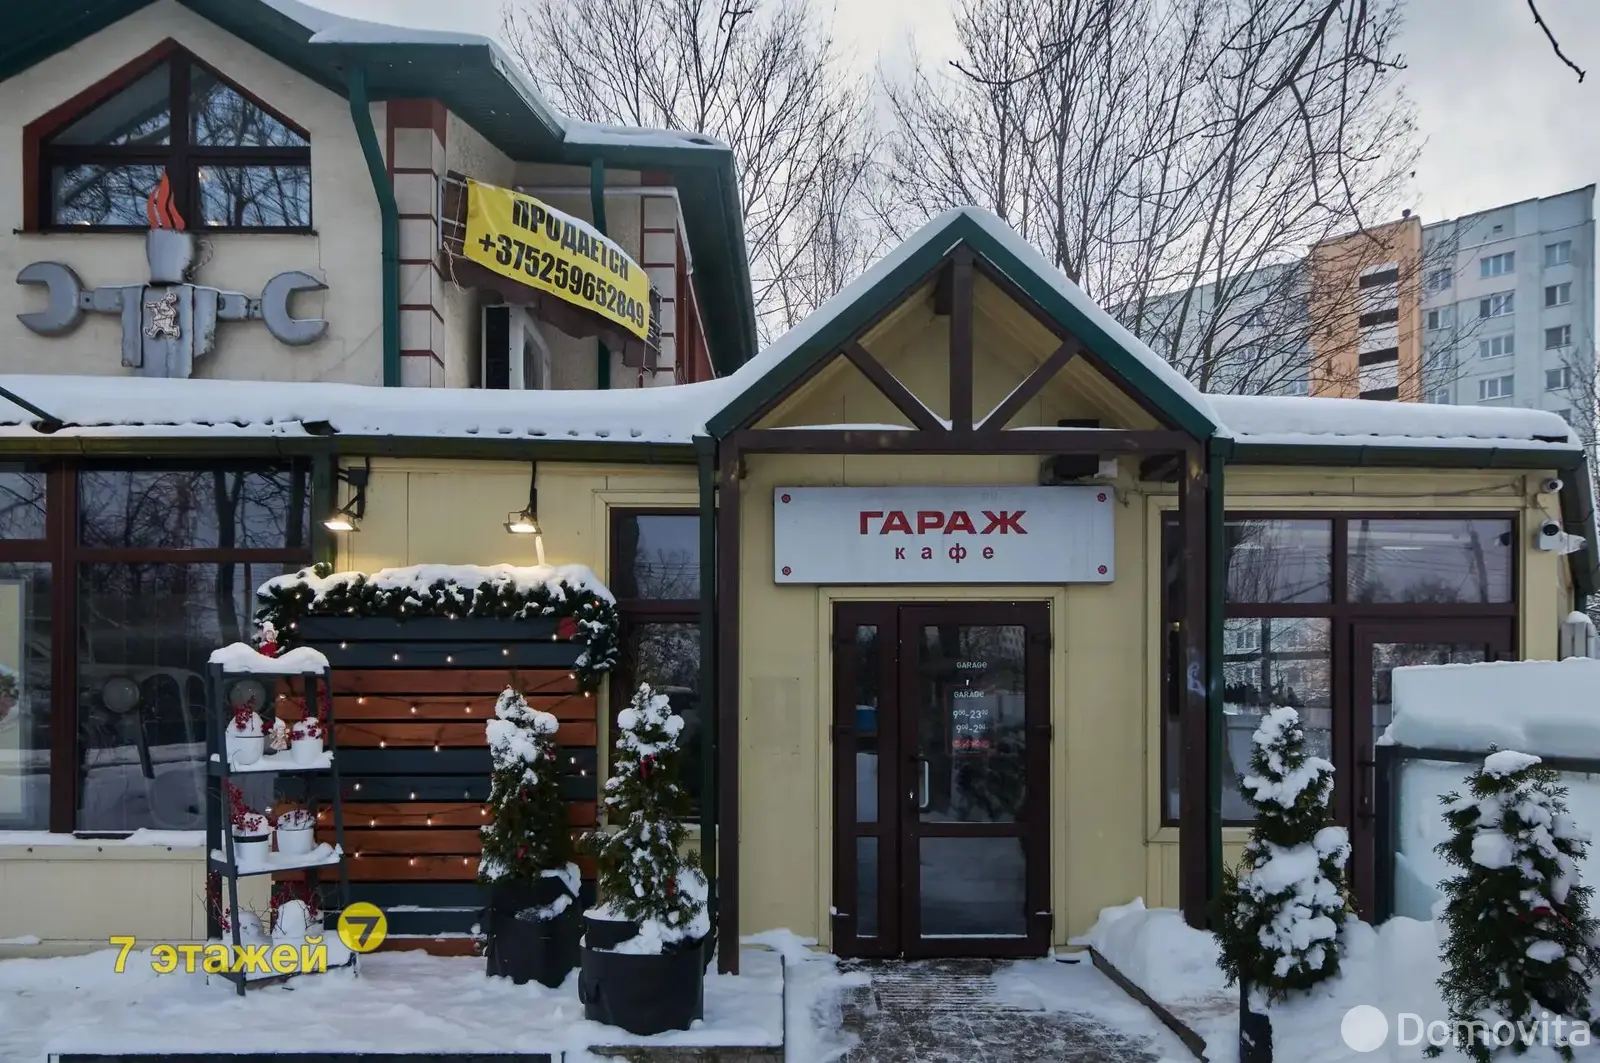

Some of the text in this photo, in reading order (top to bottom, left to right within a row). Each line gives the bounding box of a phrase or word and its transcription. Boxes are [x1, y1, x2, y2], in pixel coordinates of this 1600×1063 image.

[478, 233, 645, 329] +375259652849
[859, 510, 1028, 535] ГАРАЖ
[895, 543, 994, 564] кафе
